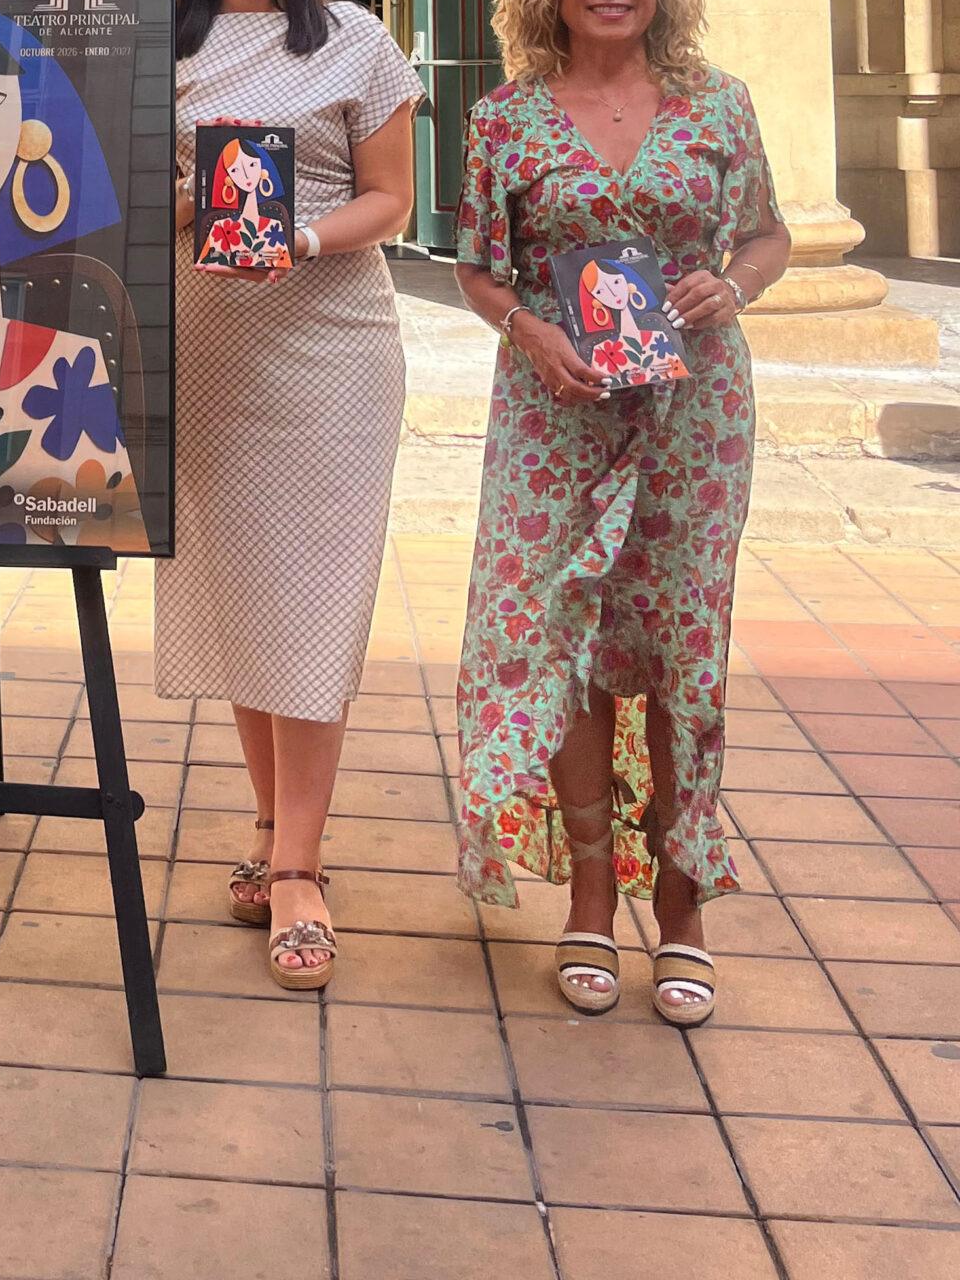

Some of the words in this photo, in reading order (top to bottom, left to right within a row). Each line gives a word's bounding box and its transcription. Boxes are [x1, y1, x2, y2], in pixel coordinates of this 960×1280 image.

[14, 14, 67, 26] TEATRO
[69, 13, 140, 25] PRINCIPAL
[39, 28, 52, 36] DE
[60, 27, 113, 36] ALICANTE
[20, 47, 55, 57] OCTUBRE
[84, 47, 110, 56] ENERO
[25, 515, 77, 526] Fundación
